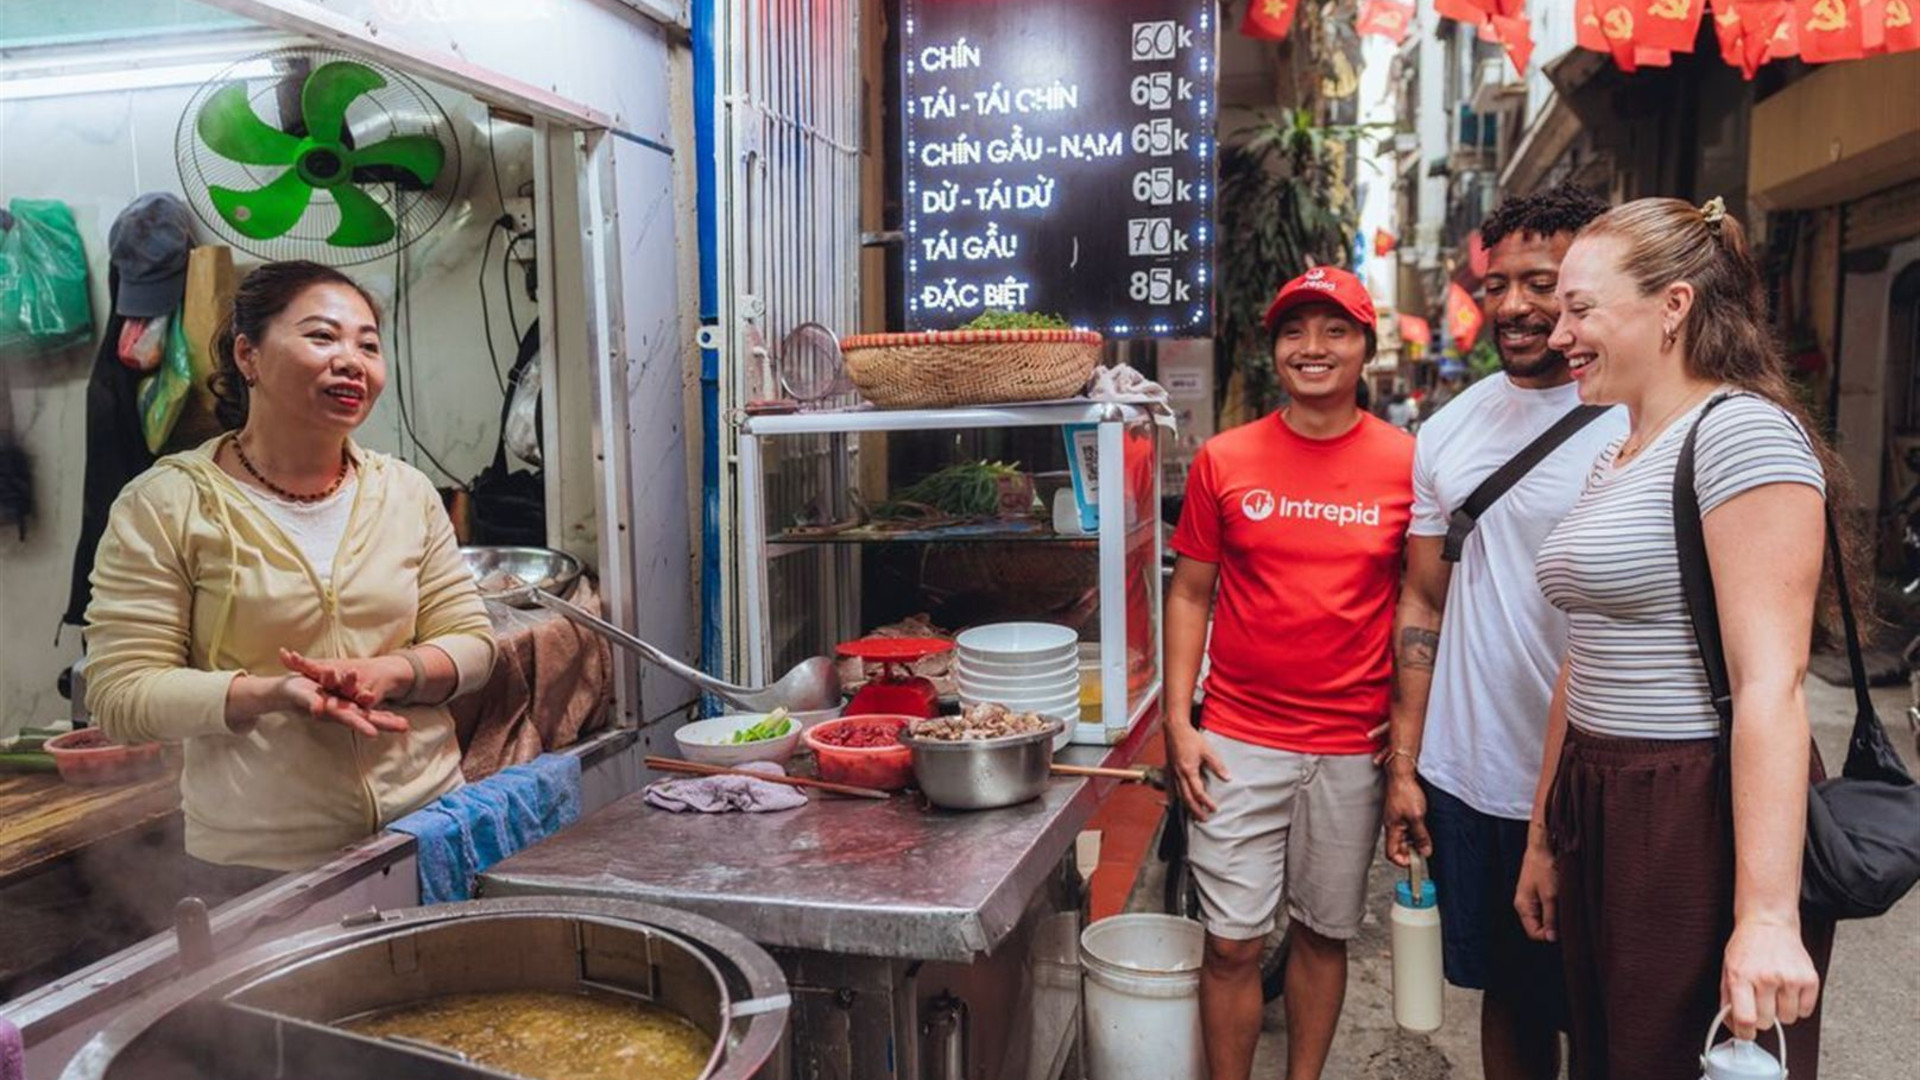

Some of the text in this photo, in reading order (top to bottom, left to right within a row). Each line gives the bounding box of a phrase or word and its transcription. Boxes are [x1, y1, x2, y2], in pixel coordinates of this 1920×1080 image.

[921, 37, 981, 71] CHÍN
[920, 86, 956, 119] TÁI
[974, 81, 1010, 115] TÁI
[1015, 79, 1078, 112] CHÍN
[921, 133, 981, 167] CHÍN
[1060, 132, 1123, 161] NẠM
[922, 179, 960, 213] DỪ
[975, 178, 1012, 211] TÁI
[1016, 174, 1055, 208] DỪ
[922, 229, 957, 261] TÁI
[920, 278, 979, 312] ĐẶC
[984, 275, 1029, 311] BIỆT
[1279, 496, 1380, 527] Intrepid
